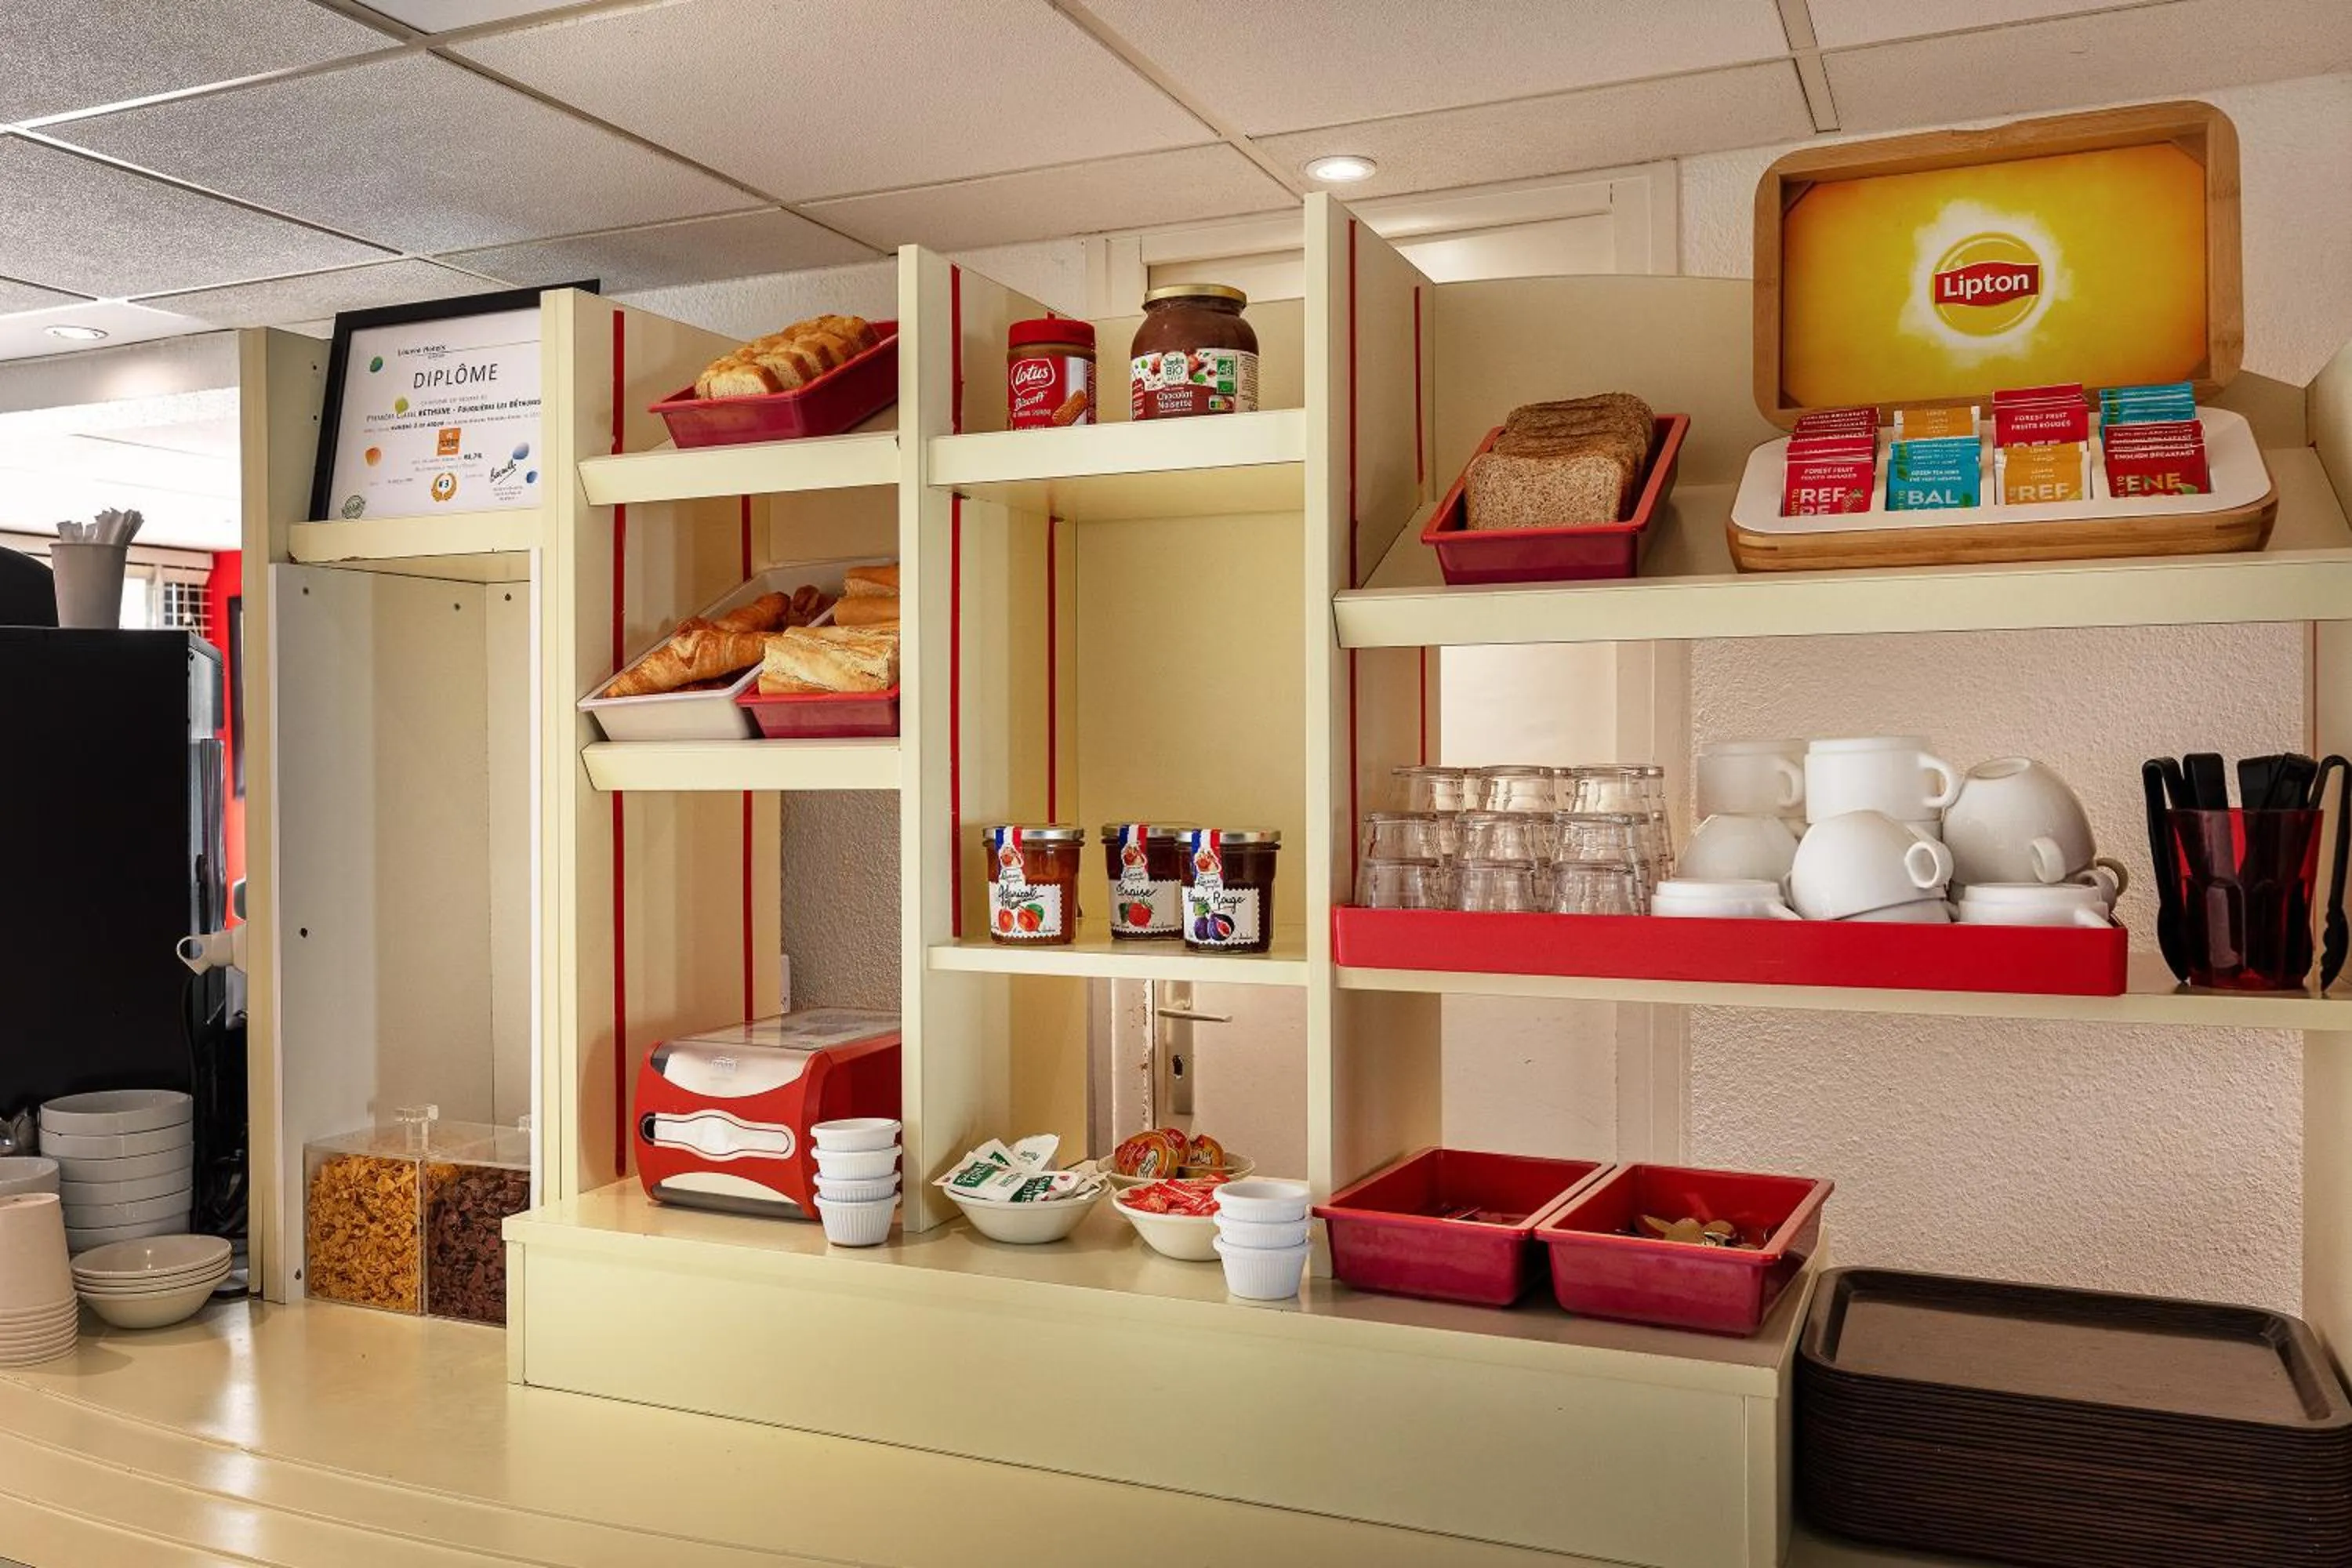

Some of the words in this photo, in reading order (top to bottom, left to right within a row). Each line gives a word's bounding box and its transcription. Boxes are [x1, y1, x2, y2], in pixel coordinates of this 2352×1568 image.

[1944, 274, 2029, 300] Lipton
[413, 363, 498, 390] DIPLÔME
[1015, 364, 1048, 386] Lotus
[1156, 390, 1192, 401] Chocolat
[2011, 423, 2038, 431] FRUITS
[2039, 419, 2071, 429] ROUGES
[2150, 449, 2195, 459] BREAKFAST
[2125, 472, 2181, 492] ENE
[1800, 487, 1846, 503] REF
[1907, 489, 1959, 505] BAL
[2018, 482, 2070, 501] REF
